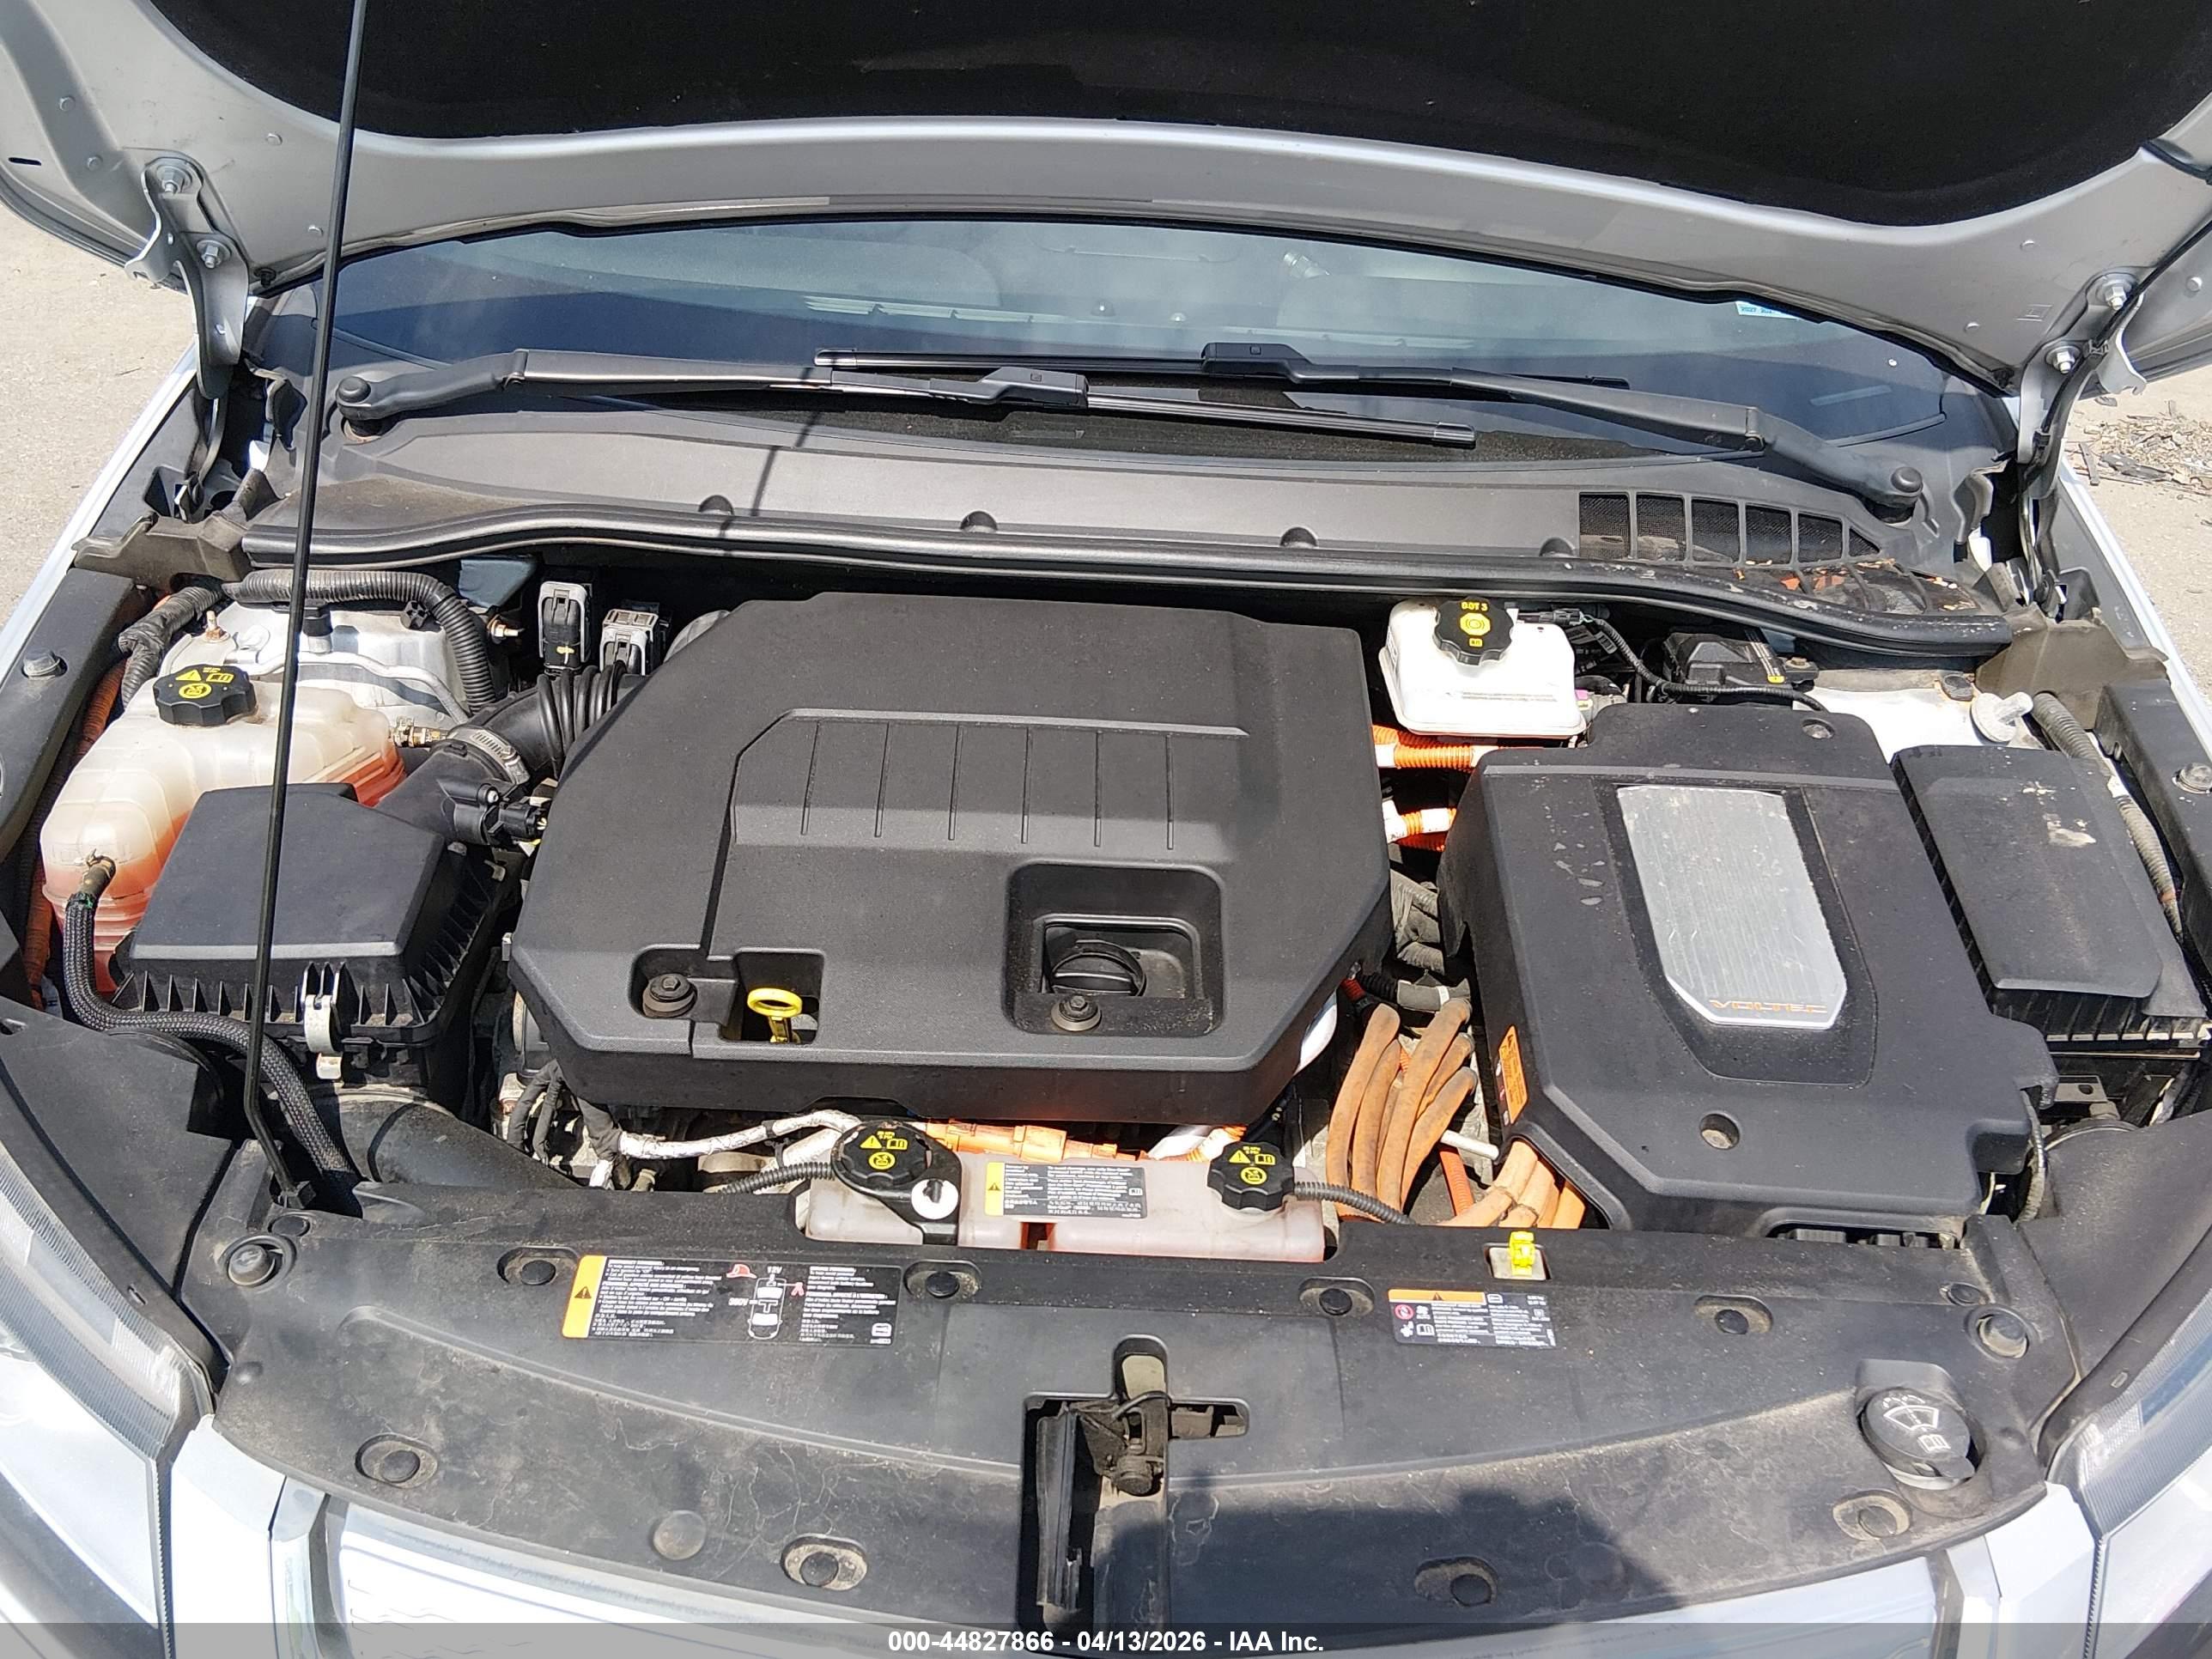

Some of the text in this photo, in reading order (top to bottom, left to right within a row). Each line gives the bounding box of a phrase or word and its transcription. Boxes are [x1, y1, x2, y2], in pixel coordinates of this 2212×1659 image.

[1461, 601, 1488, 611] DOT 3
[1708, 999, 1828, 1014] VOLTEC
[767, 1265, 783, 1274] 12V
